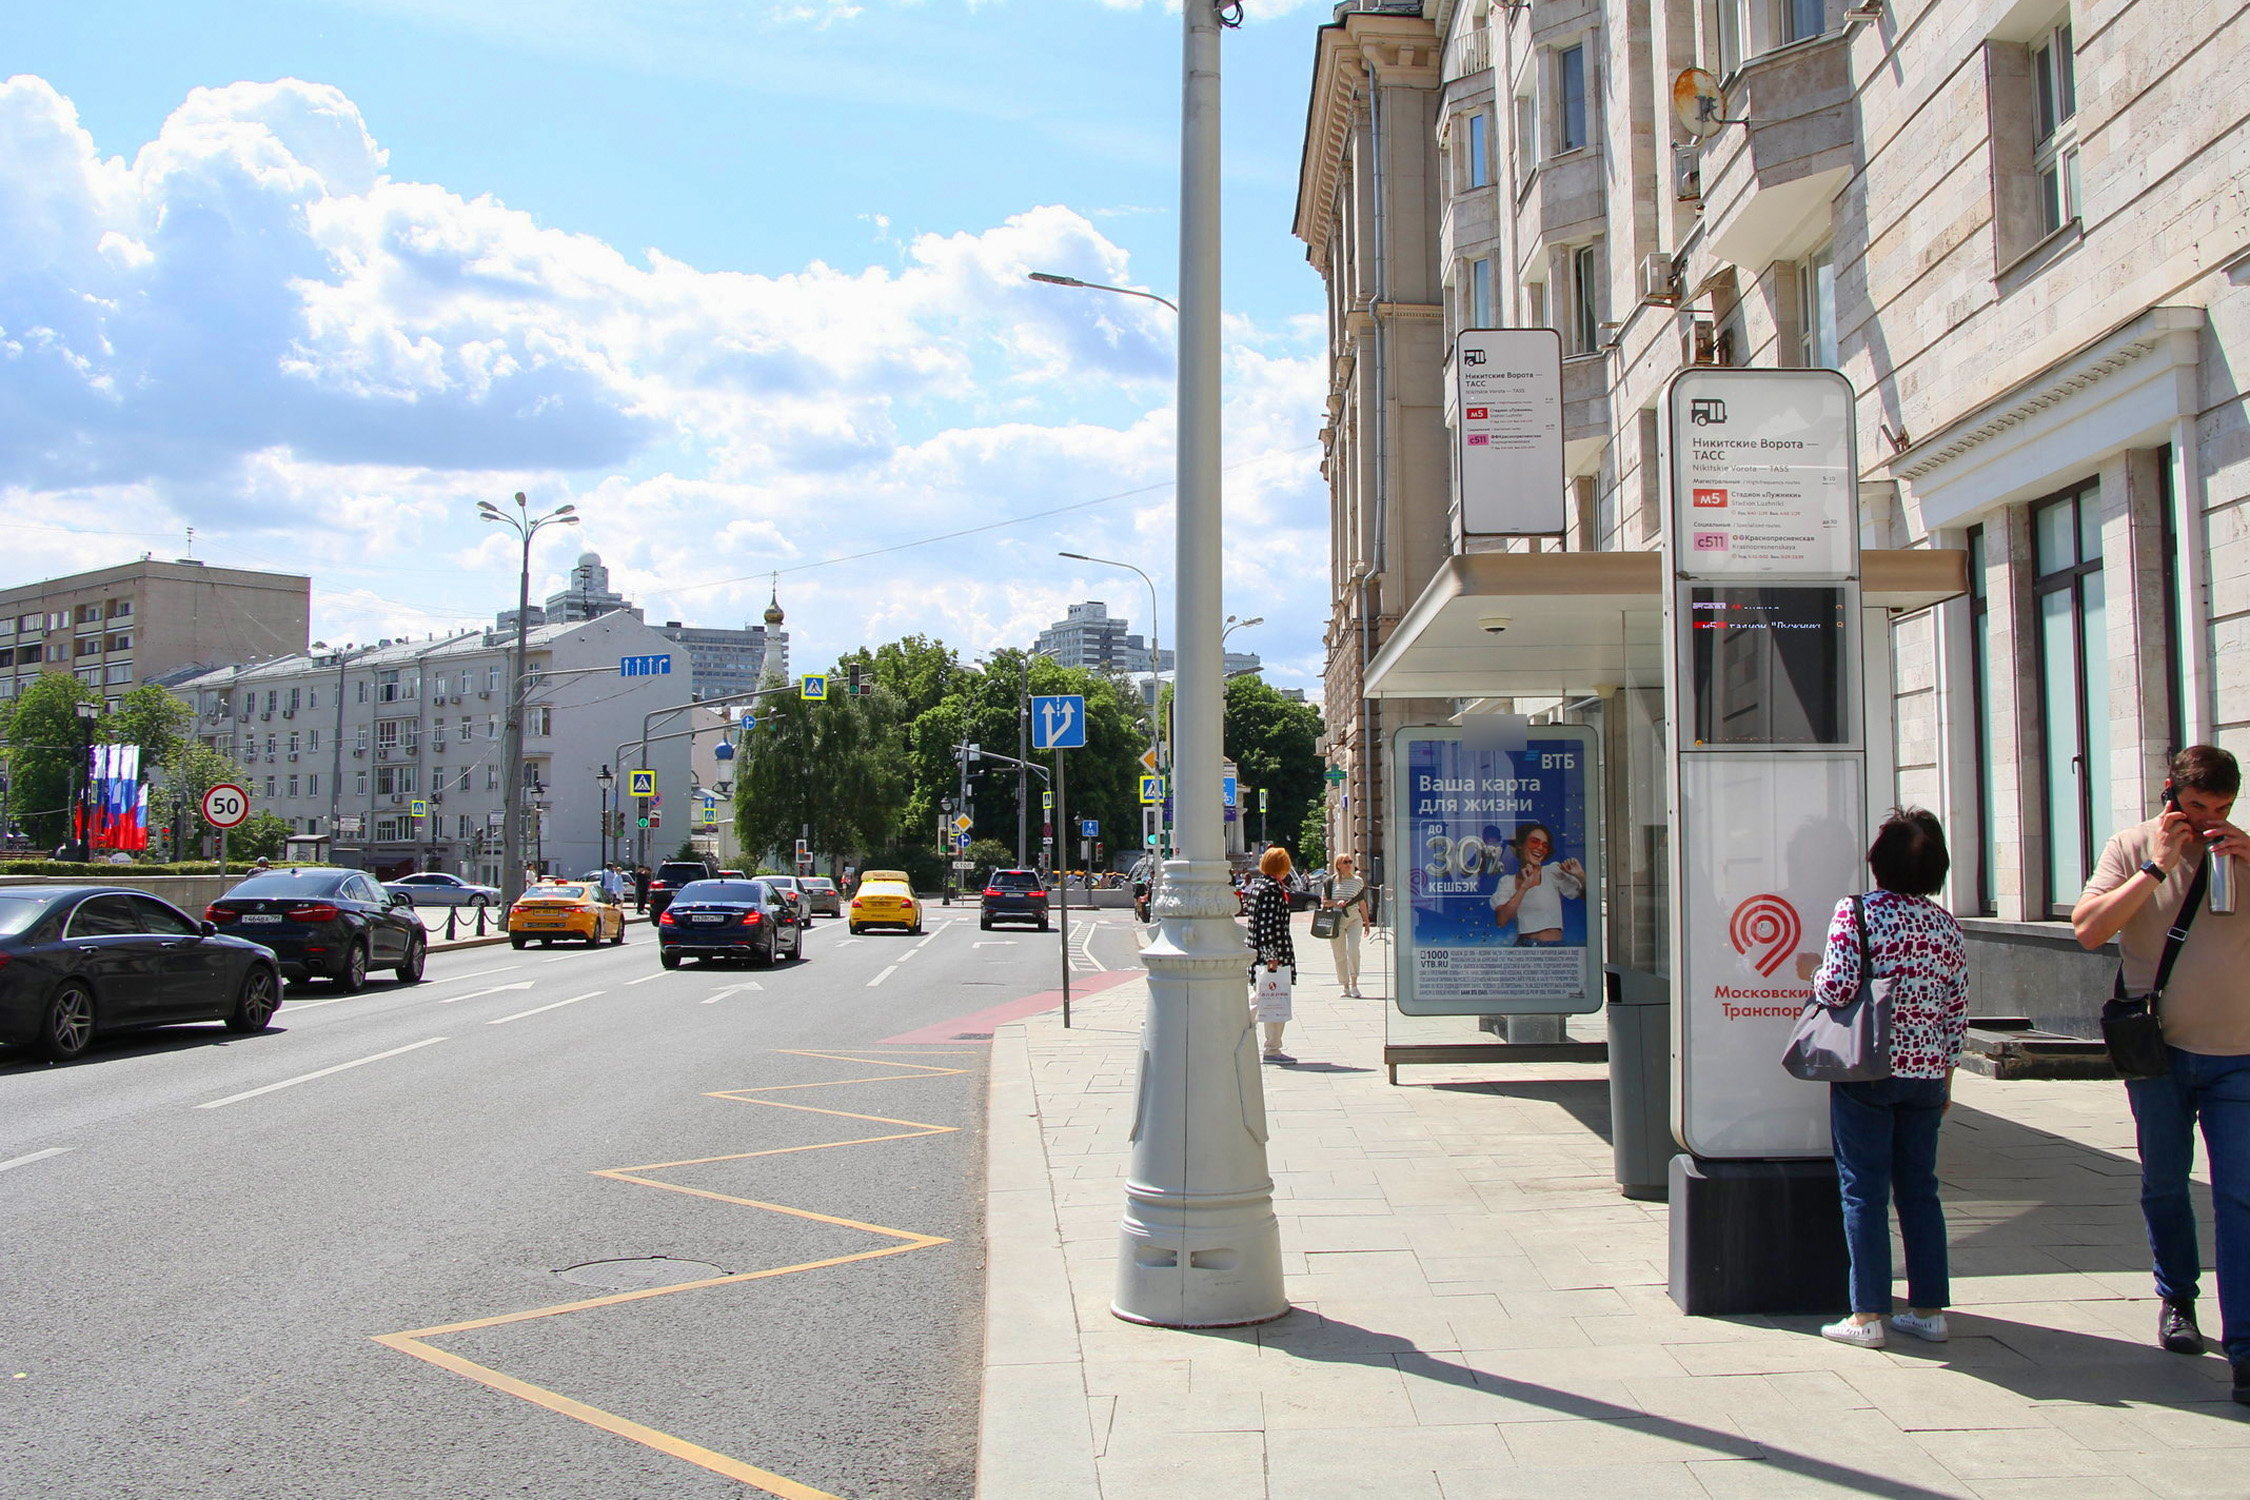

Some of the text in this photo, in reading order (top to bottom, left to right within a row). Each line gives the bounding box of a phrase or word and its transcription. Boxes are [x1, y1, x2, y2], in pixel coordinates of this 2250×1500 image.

[1507, 372, 1534, 380] Ворота
[1470, 409, 1484, 418] м5
[1693, 438, 1757, 449] Никитские
[1760, 438, 1804, 450] Ворота
[1693, 450, 1726, 461] ТАСС
[1731, 464, 1757, 472] Vorota
[1700, 492, 1721, 504] м5
[1697, 537, 1724, 547] с511
[1541, 753, 1575, 769] ВТБ
[1419, 775, 1541, 796] Ваша карта
[214, 797, 239, 814] 50
[1419, 799, 1533, 814] для жизни
[1425, 835, 1504, 877] 30%
[1428, 882, 1478, 893] КЕШБЭК
[1427, 950, 1448, 959] 1000
[1420, 960, 1448, 968] VTB.RU
[1721, 1002, 1804, 1021] Транспор
